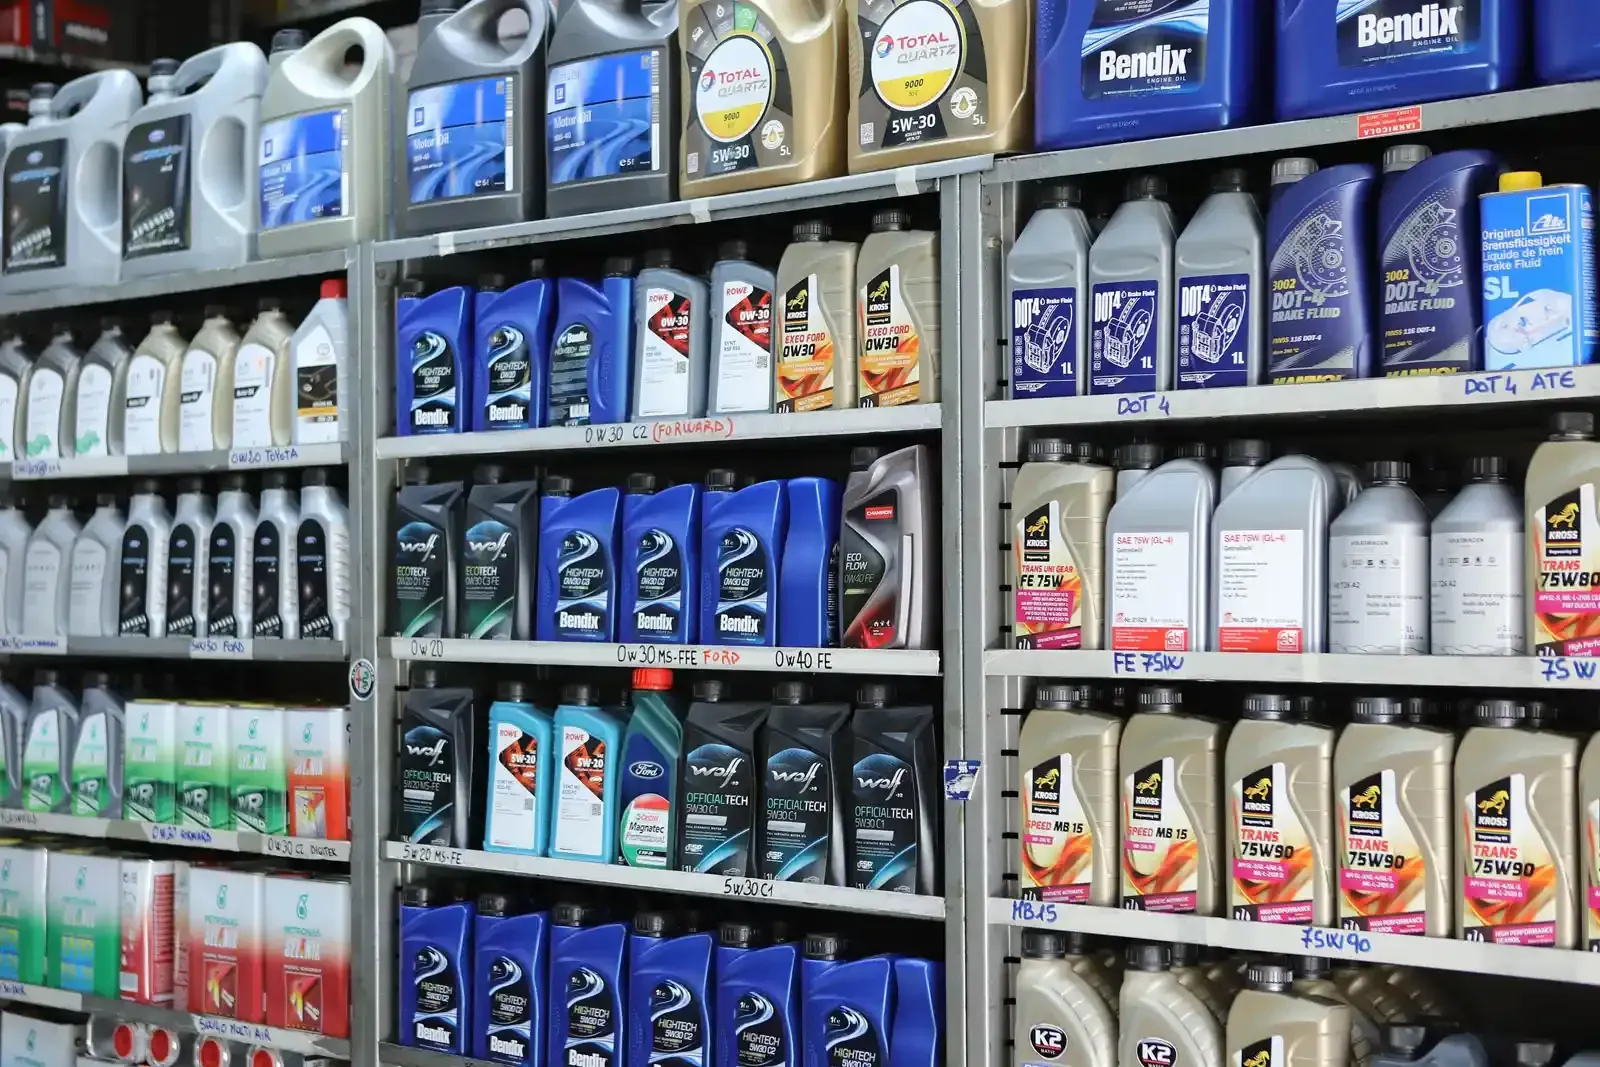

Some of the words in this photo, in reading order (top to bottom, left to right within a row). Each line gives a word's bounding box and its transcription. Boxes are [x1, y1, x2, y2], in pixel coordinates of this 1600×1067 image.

[900, 34, 950, 50] TOTAL
[1412, 38, 1442, 48] ENGINE
[718, 68, 761, 84] TOTAL
[1146, 76, 1172, 84] ENGINE
[904, 78, 924, 89] 9000
[724, 111, 740, 122] 9000
[973, 112, 986, 126] 5L
[891, 113, 936, 135] 5W-30
[712, 146, 750, 164] 5W-30
[780, 146, 792, 156] 5L
[1482, 229, 1524, 244] Original
[1522, 249, 1535, 258] de
[1538, 246, 1563, 257] frein
[1384, 270, 1409, 283] 3002
[726, 286, 748, 297] ROWE
[1272, 278, 1296, 292] 3002
[1384, 280, 1440, 303] DOT-4
[1484, 276, 1519, 301] SL
[1272, 288, 1326, 310] DOT-4
[868, 302, 889, 312] KROSS
[1384, 300, 1418, 315] BRAKE
[1420, 298, 1456, 312] FLUID
[660, 314, 688, 328] 0W-30
[739, 308, 770, 322] 0W-30
[786, 310, 807, 321] KROSS
[1272, 308, 1304, 323] BRAKE
[1306, 308, 1340, 320] FLUID
[785, 335, 804, 345] EXEO
[804, 331, 826, 343] FORD
[867, 327, 886, 338] EXEO
[888, 324, 910, 336] FORD
[782, 342, 816, 358] 0W30
[865, 336, 899, 352] 0W30
[1140, 356, 1154, 369] 1L
[1231, 352, 1244, 366] 1L
[1060, 362, 1073, 375] 1L
[1530, 372, 1576, 390] ATE
[415, 408, 450, 426] Bendix
[489, 404, 524, 422] Bendix
[632, 425, 648, 439] C2
[1548, 530, 1578, 540] KROSS
[846, 552, 862, 562] ECO
[396, 566, 428, 577] ECOTECH
[466, 566, 497, 577] ECOTECH
[846, 561, 868, 571] FLOW
[1022, 565, 1042, 574] TRANS
[1056, 565, 1074, 574] GEAR
[1543, 560, 1580, 572] TRANS
[864, 573, 875, 584] FE
[1020, 574, 1034, 588] FE
[1036, 574, 1064, 588] 75W
[560, 611, 600, 630] Bendix
[637, 612, 673, 632] Bendix
[720, 613, 760, 634] Bendix
[659, 650, 698, 666] MS-FFE
[704, 650, 741, 665] FORD
[818, 653, 833, 669] FE
[1114, 654, 1136, 674] FE
[500, 730, 518, 738] ROWE
[565, 733, 584, 742] ROWE
[406, 739, 448, 768] wolf
[511, 754, 536, 766] 5W-20
[577, 758, 604, 769] 5W-20
[404, 769, 452, 784] OFFICIALTECH
[634, 764, 659, 778] Ford
[691, 757, 745, 788] wolf
[772, 762, 824, 795] wolf
[857, 768, 908, 802] wolf
[686, 792, 749, 806] OFFICIALTECH
[1034, 792, 1058, 801] KROSS
[1135, 796, 1160, 806] KROSS
[767, 798, 826, 813] OFFICIALTECH
[1244, 802, 1271, 812] KROSS
[855, 806, 914, 820] OFFICIALTECH
[1352, 810, 1380, 821] KROSS
[628, 822, 664, 836] Magnatec
[1027, 820, 1052, 830] SPEED
[1053, 821, 1070, 832] MB
[1072, 822, 1084, 834] 15
[1478, 816, 1508, 828] KROSS
[1128, 826, 1154, 838] SPEED
[1156, 828, 1173, 838] MB
[1176, 828, 1188, 839] 15
[1241, 828, 1280, 842] TRANS
[1241, 841, 1294, 859] 75W90
[1348, 838, 1389, 852] TRANS
[1473, 844, 1518, 860] TRANS
[436, 848, 462, 864] MS-FE
[1348, 852, 1405, 869] 75W90
[1472, 858, 1536, 878] 75W90
[760, 884, 774, 898] C1
[1508, 928, 1554, 938] PERFORMANCE
[574, 1004, 610, 1019] HIGHTECH
[658, 1018, 698, 1032] HIGHTECH
[742, 1032, 780, 1046] HIGHTECH
[1034, 1028, 1062, 1048] K2
[490, 1035, 525, 1058] Bendix
[1141, 1041, 1172, 1061] K2
[833, 1046, 876, 1062] HIGHTECH
